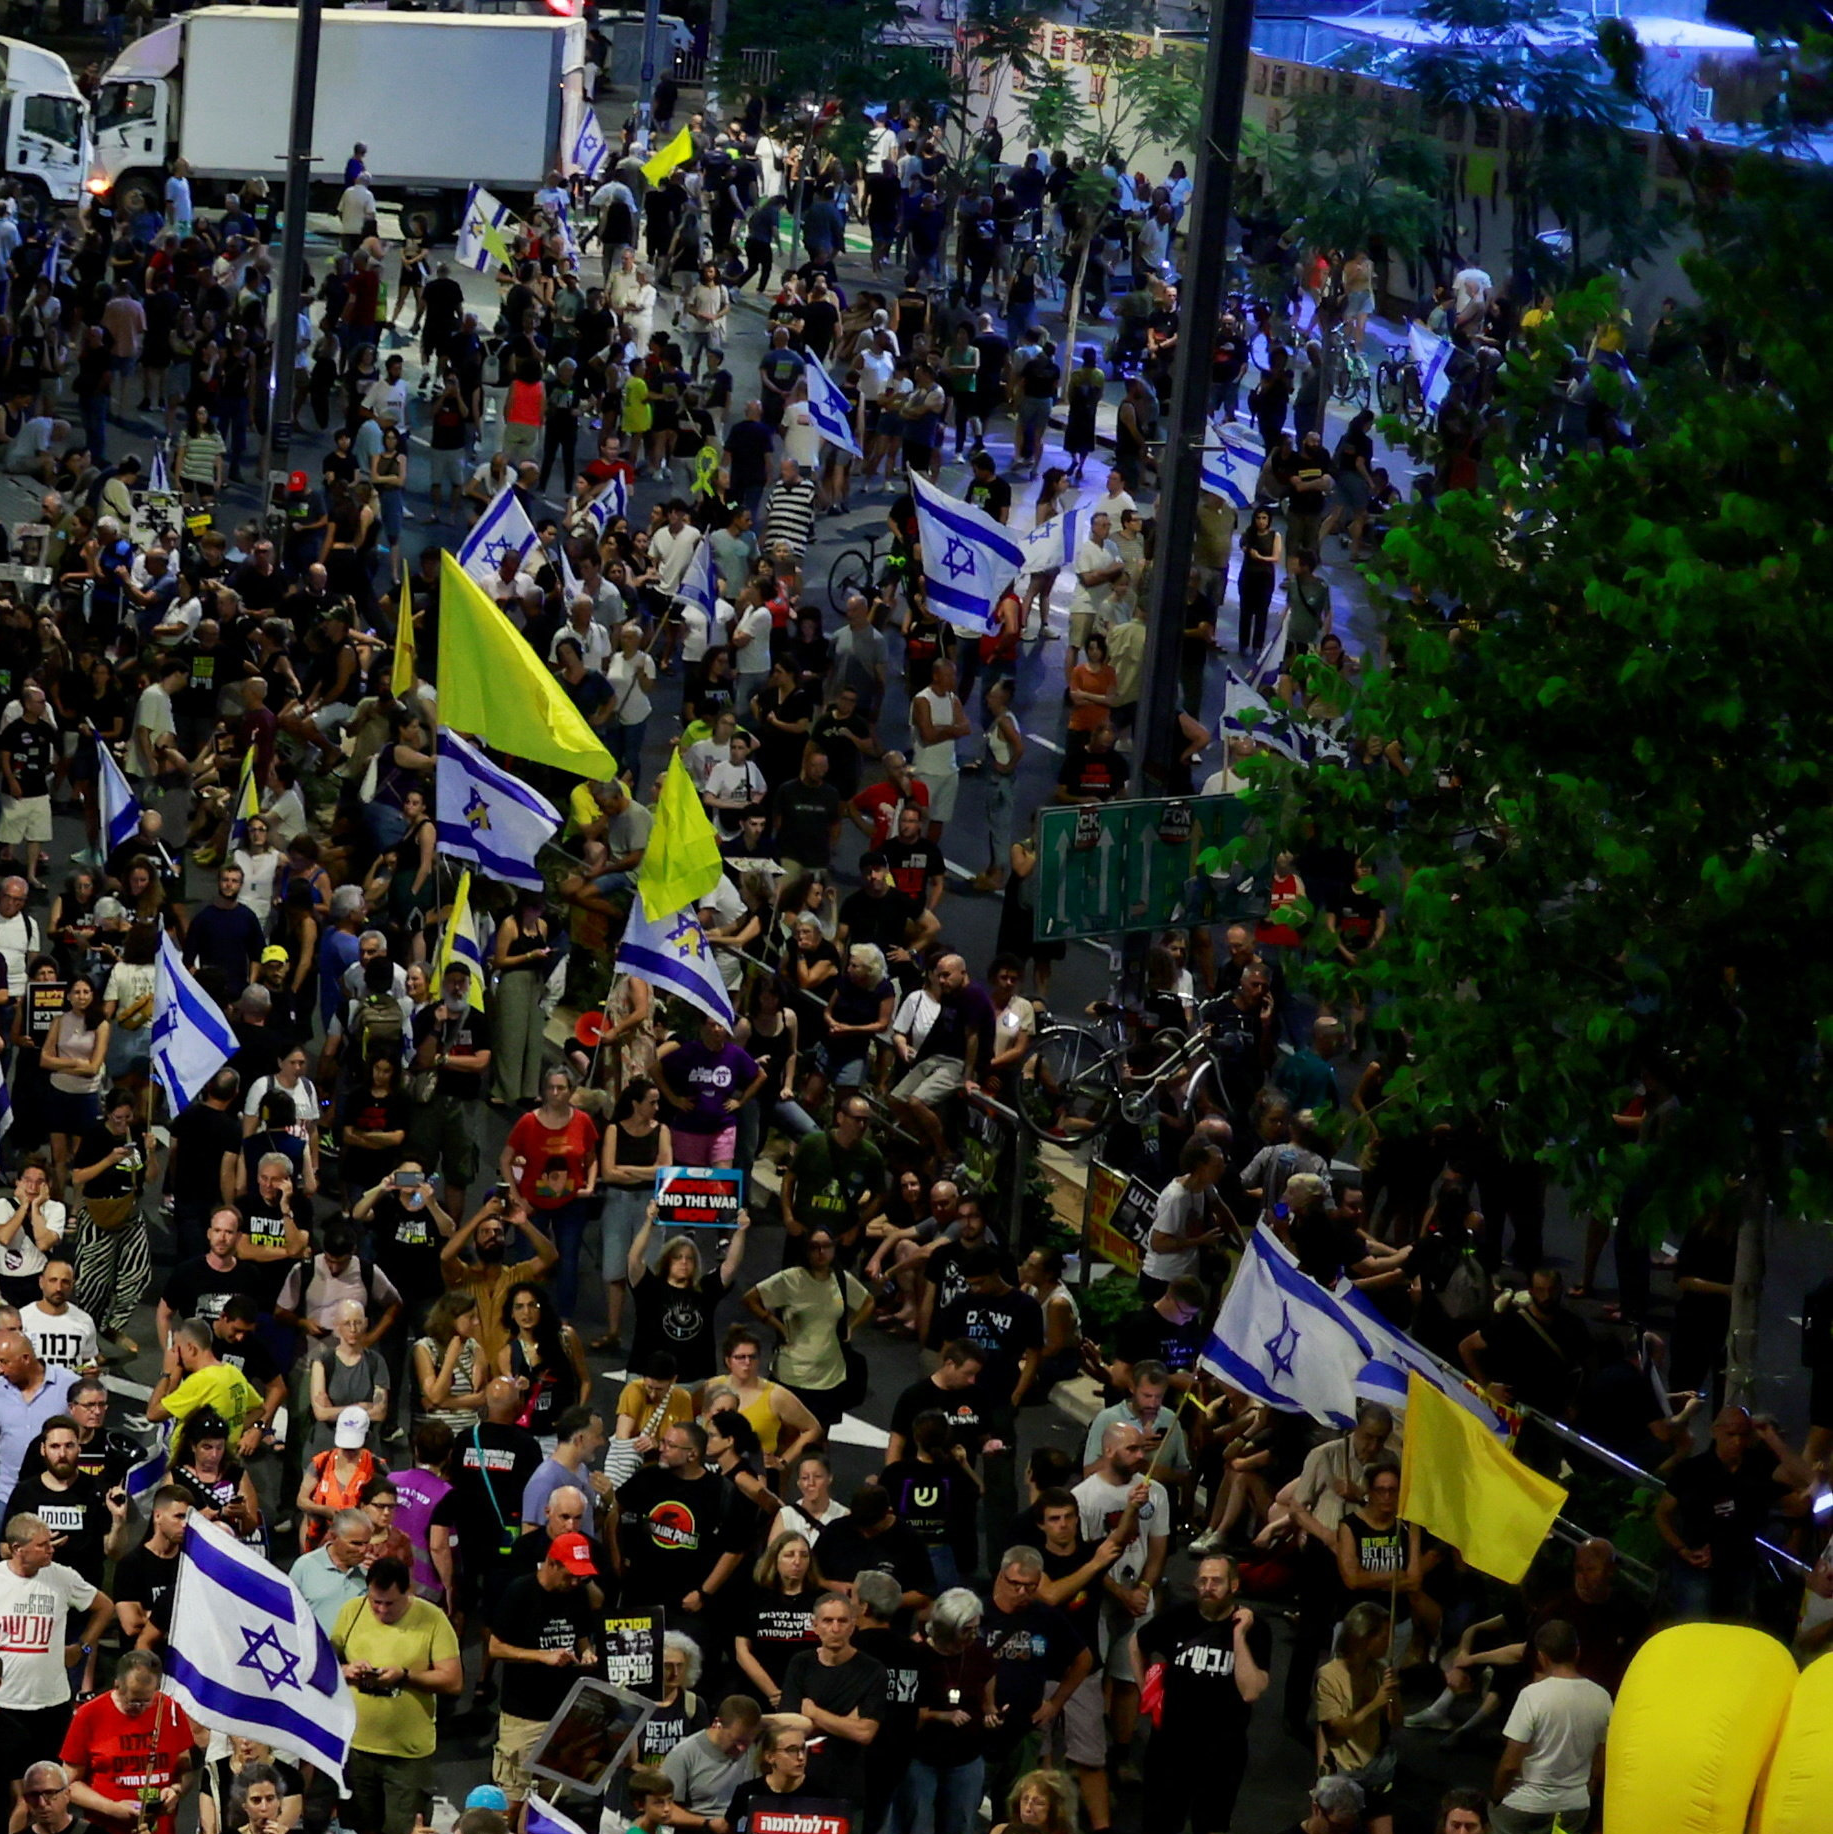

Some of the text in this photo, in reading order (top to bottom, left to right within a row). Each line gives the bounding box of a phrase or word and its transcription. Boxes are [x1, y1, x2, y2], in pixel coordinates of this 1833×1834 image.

[658, 1191, 738, 1209] END THE WAR
[760, 1814, 821, 1834] למלחמה
